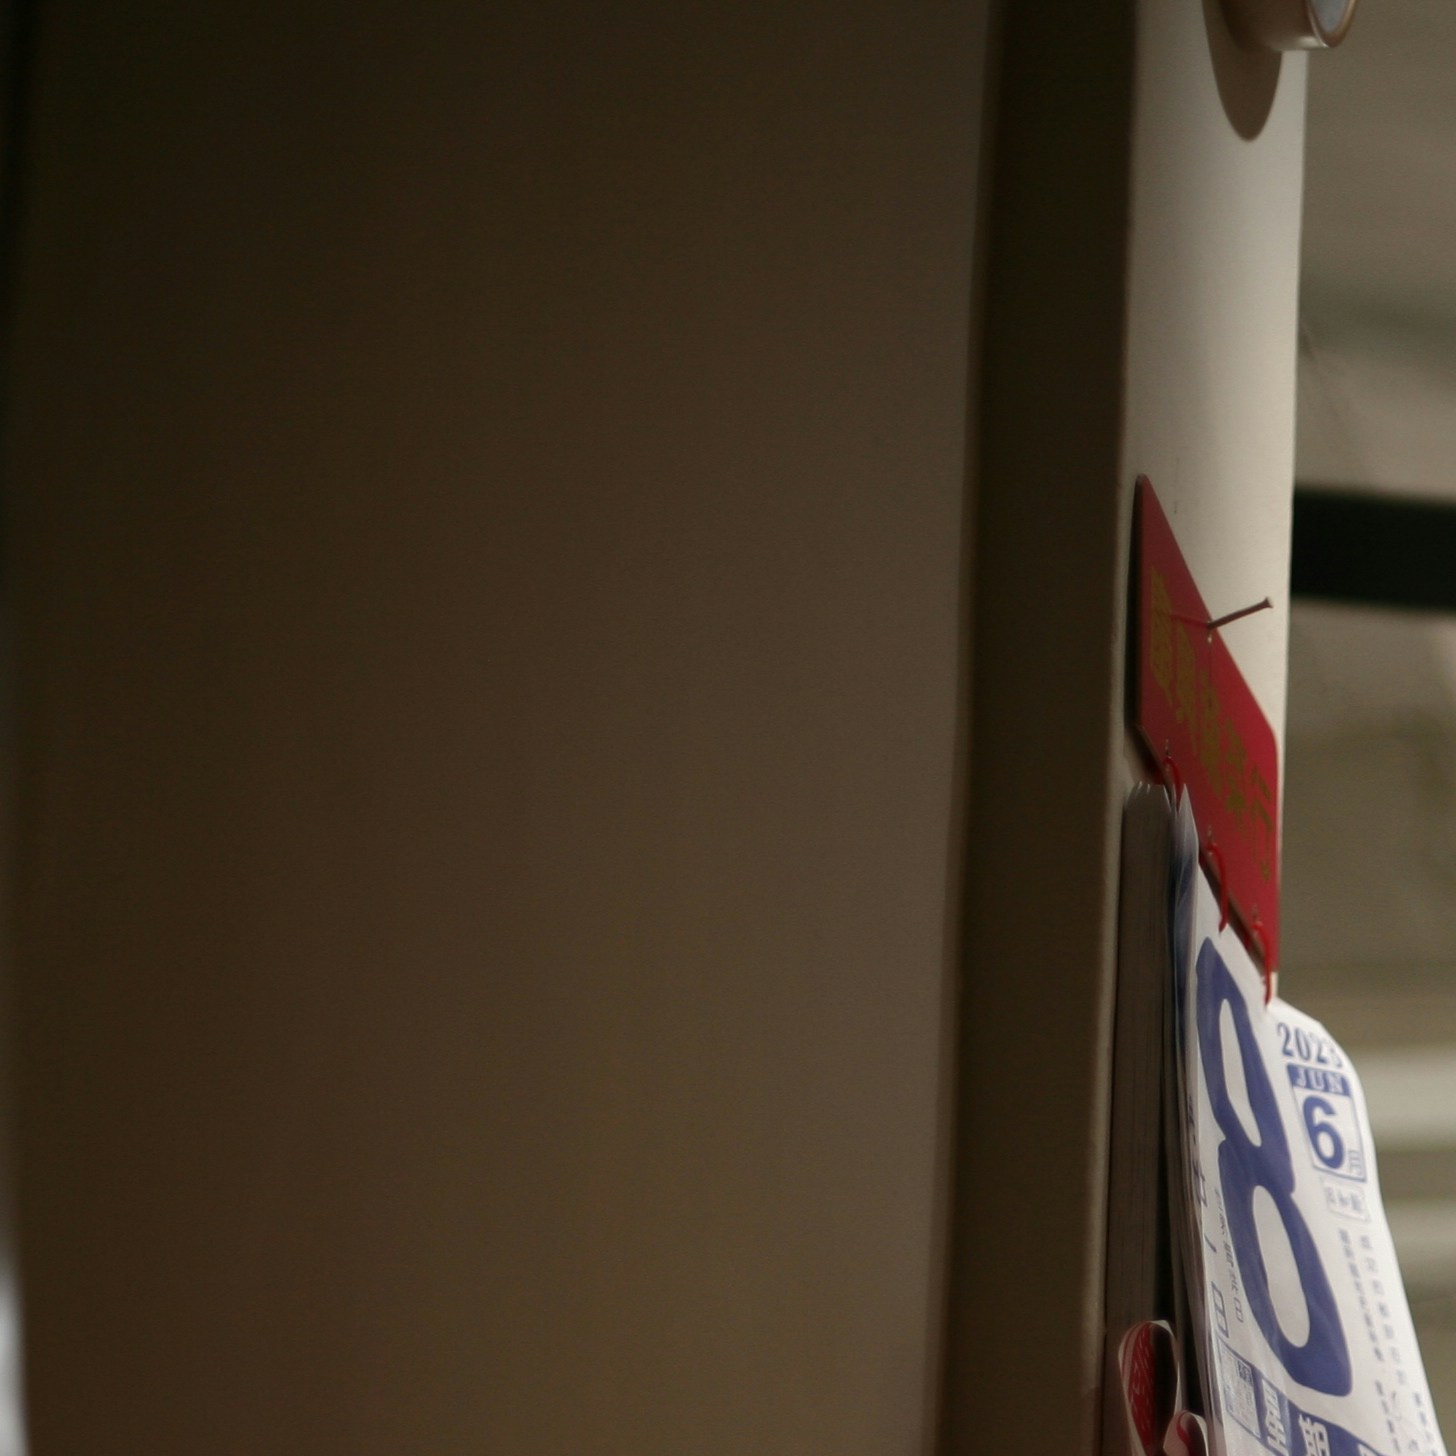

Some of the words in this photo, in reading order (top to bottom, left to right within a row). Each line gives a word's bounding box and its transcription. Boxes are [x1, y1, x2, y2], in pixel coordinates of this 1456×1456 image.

[1277, 1022, 1343, 1068] 2023
[1295, 1066, 1342, 1092] JUN
[1196, 938, 1353, 1397] 8
